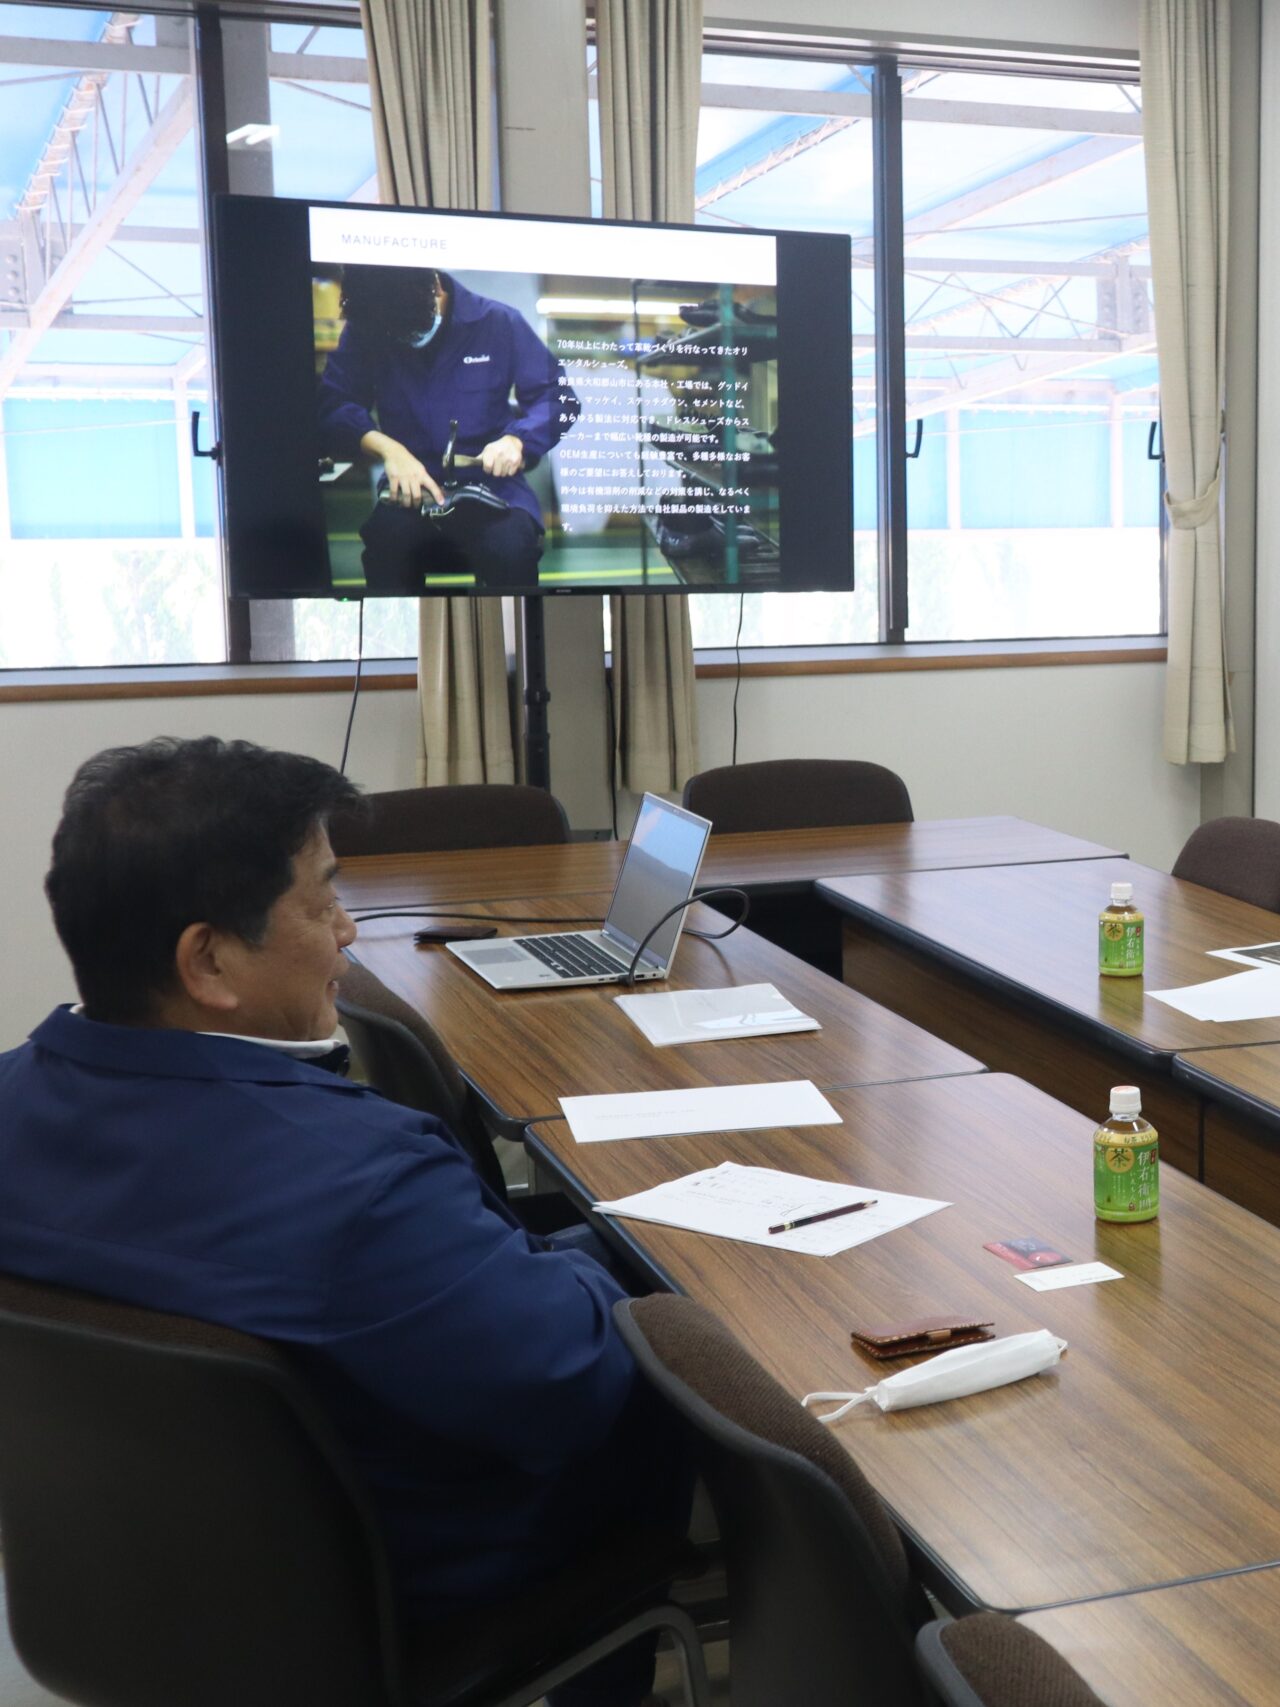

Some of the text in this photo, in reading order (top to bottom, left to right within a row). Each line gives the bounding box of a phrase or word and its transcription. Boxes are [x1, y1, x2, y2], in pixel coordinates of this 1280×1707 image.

[341, 234, 447, 250] MANUFACTURE
[558, 358, 629, 370] エンタルシューズ。
[561, 522, 573, 532] す。
[1108, 1148, 1132, 1169] 茶
[1137, 1151, 1152, 1212] 伊右衛門
